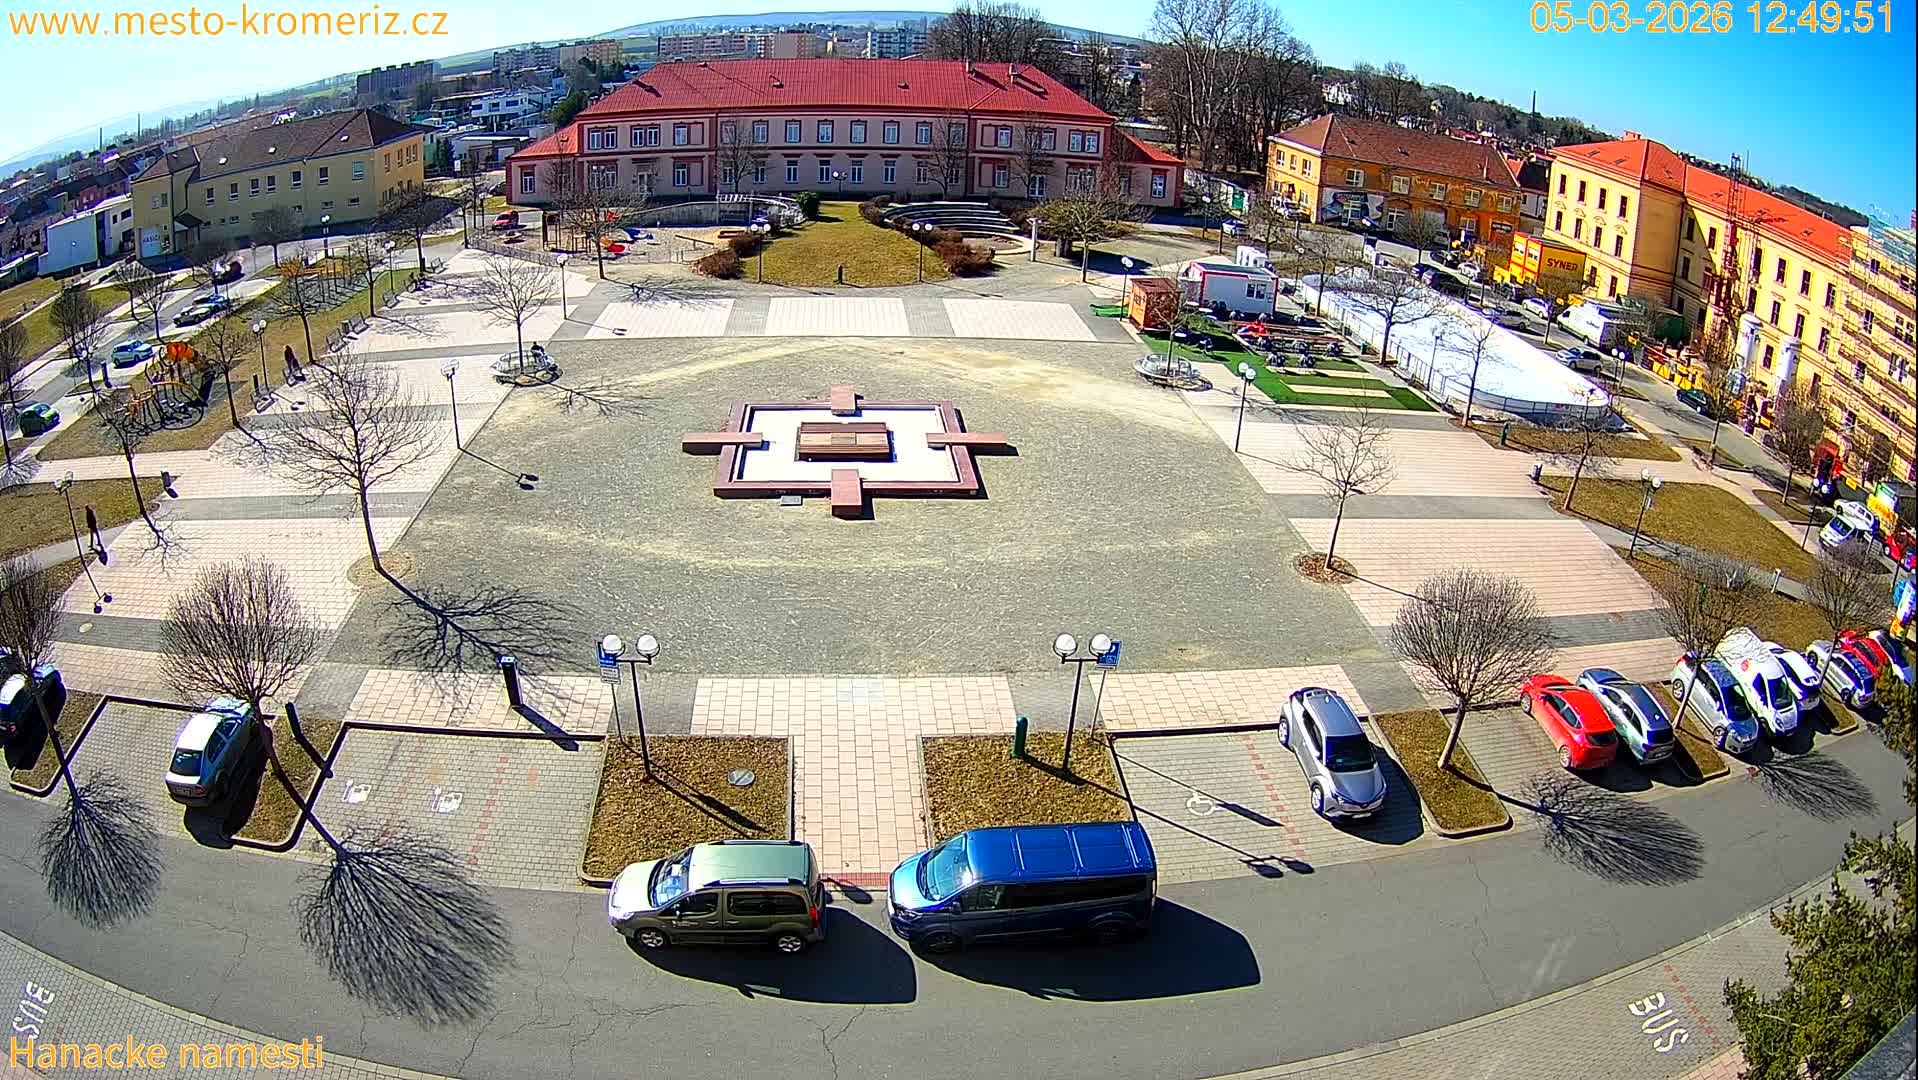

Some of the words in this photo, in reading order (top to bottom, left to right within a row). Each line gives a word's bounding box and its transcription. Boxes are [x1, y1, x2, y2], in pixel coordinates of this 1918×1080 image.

[1546, 258, 1578, 272] SYNER
[12, 981, 55, 1040] BUS
[1628, 991, 1689, 1053] BUS
